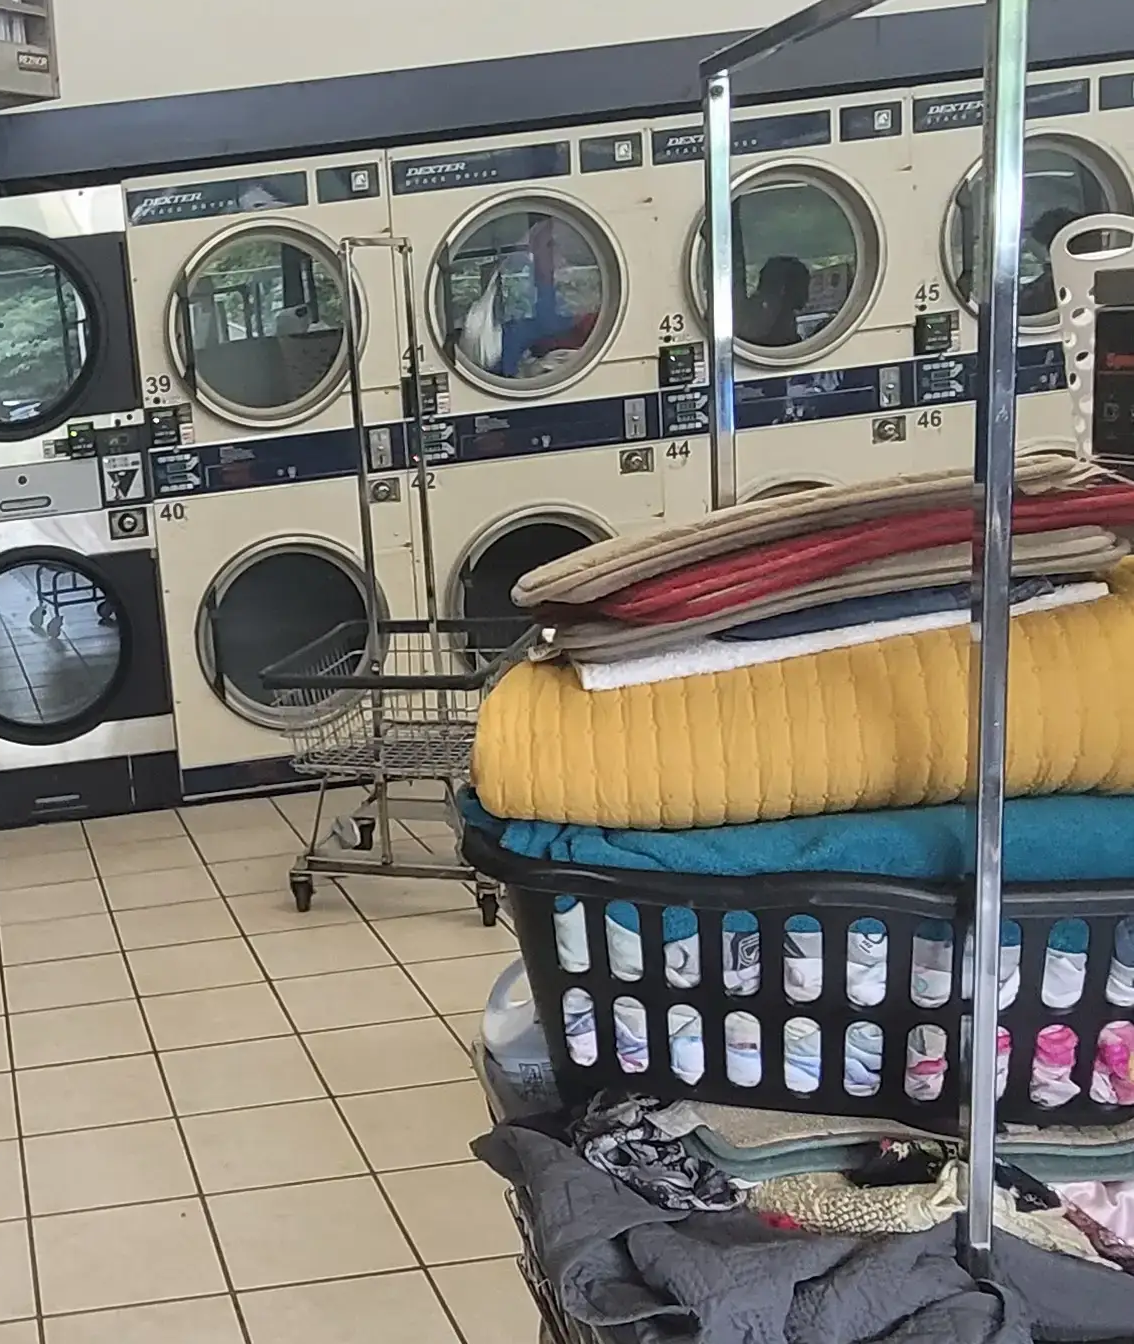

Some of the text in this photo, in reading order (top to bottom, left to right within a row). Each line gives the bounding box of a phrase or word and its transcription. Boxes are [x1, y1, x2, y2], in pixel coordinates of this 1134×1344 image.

[666, 134, 705, 146] DEXT
[405, 162, 466, 176] DEXTER
[142, 192, 203, 207] DEXTER
[915, 283, 940, 302] 45
[659, 314, 684, 333] 43
[145, 375, 171, 394] 39
[917, 410, 942, 428] 46
[666, 440, 691, 459] 44
[160, 502, 185, 522] 40
